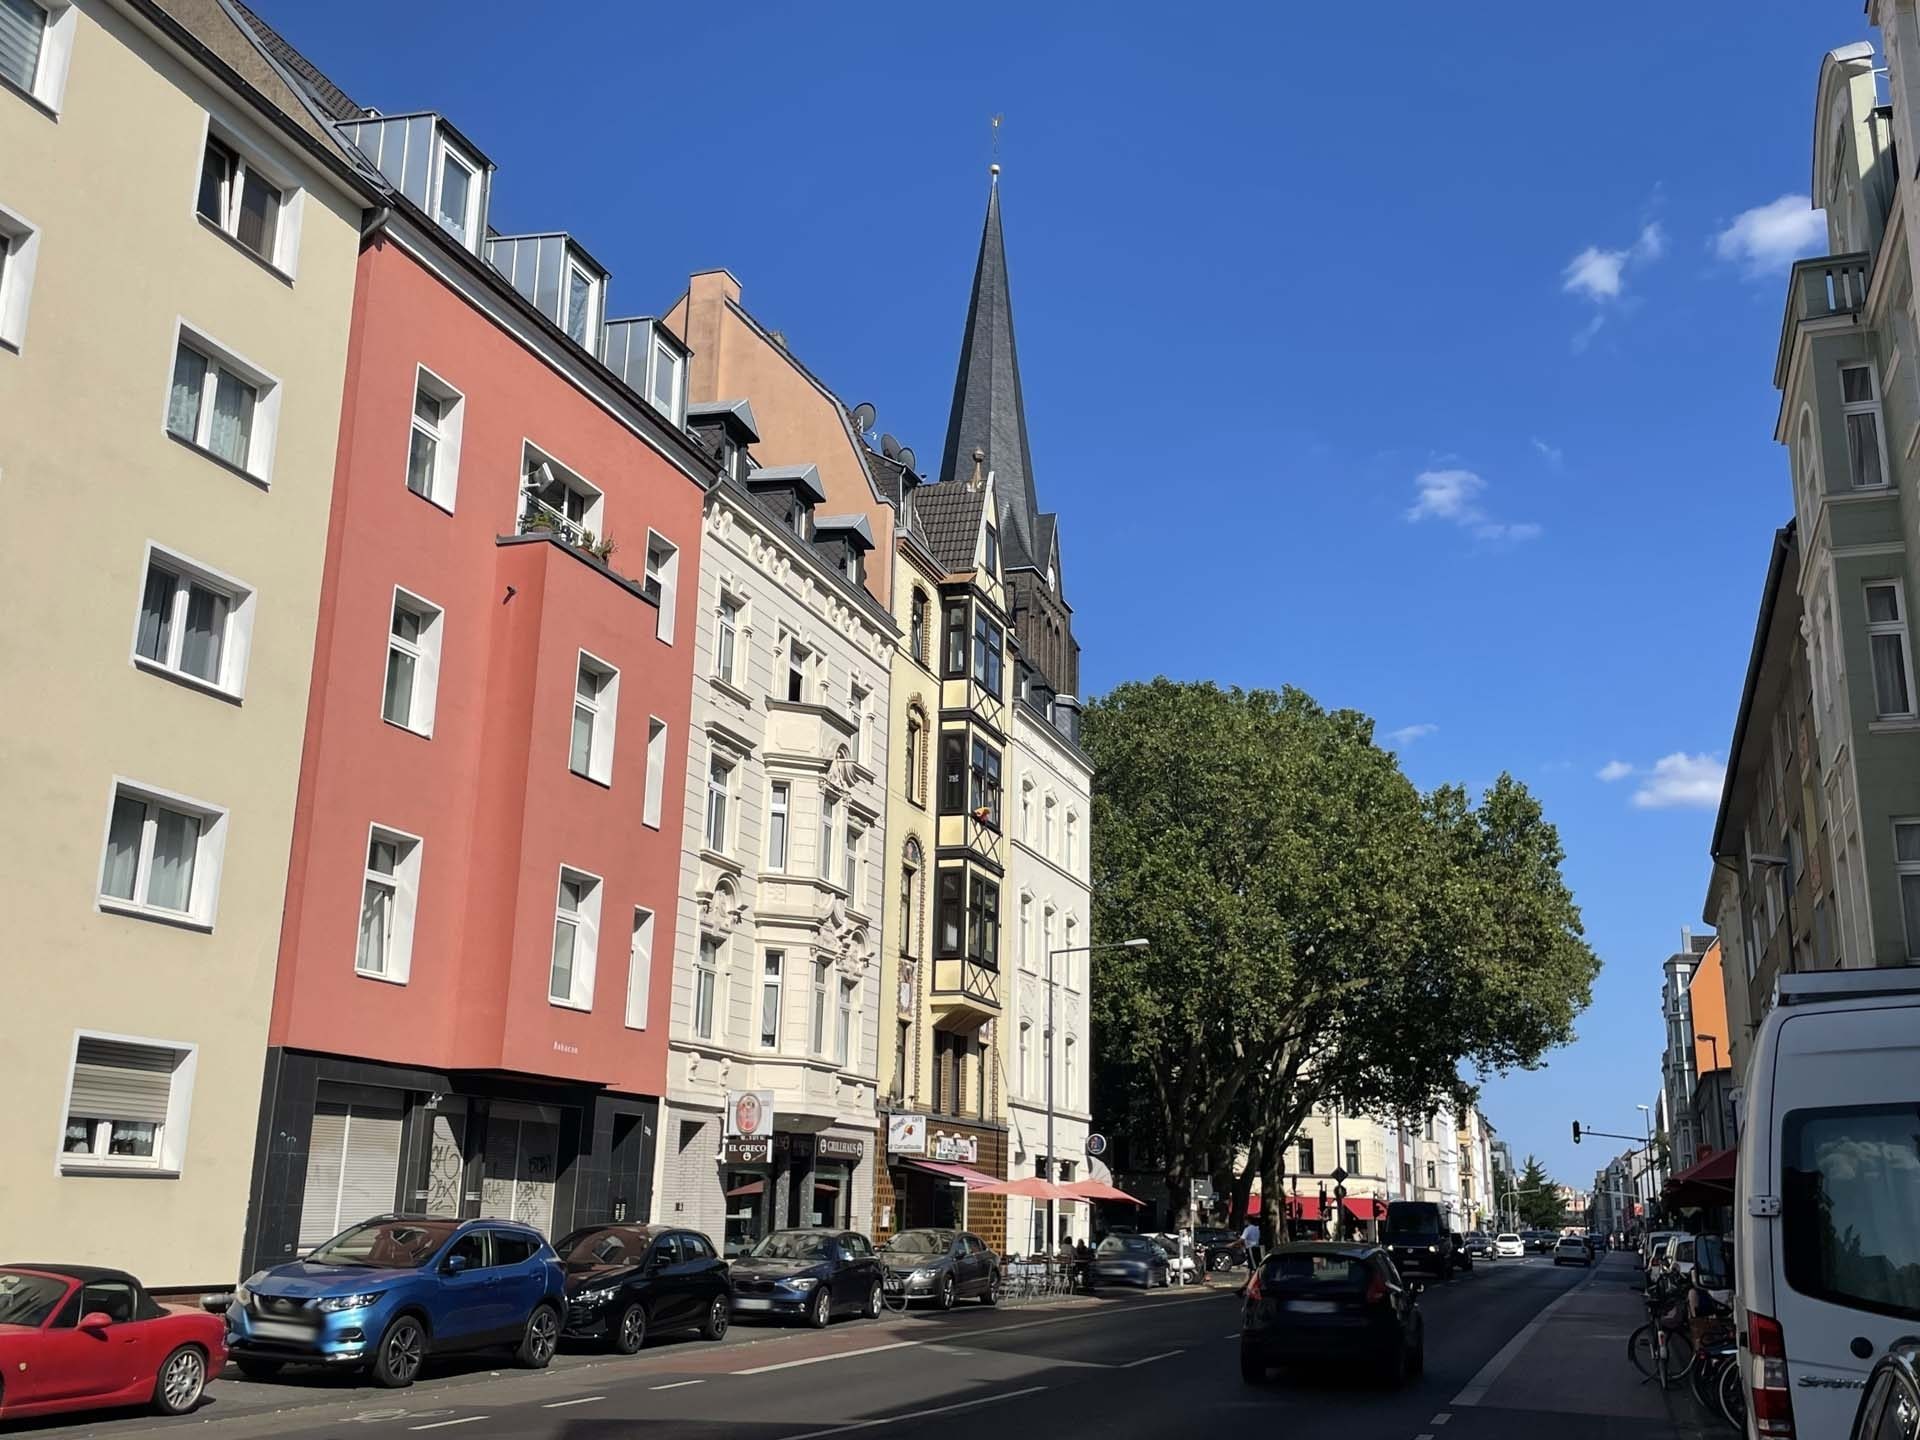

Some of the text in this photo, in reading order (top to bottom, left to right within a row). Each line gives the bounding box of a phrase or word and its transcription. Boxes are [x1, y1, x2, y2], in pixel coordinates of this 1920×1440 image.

[729, 1144, 767, 1152] EL GRECO
[827, 1140, 857, 1154] GRILLHAUS
